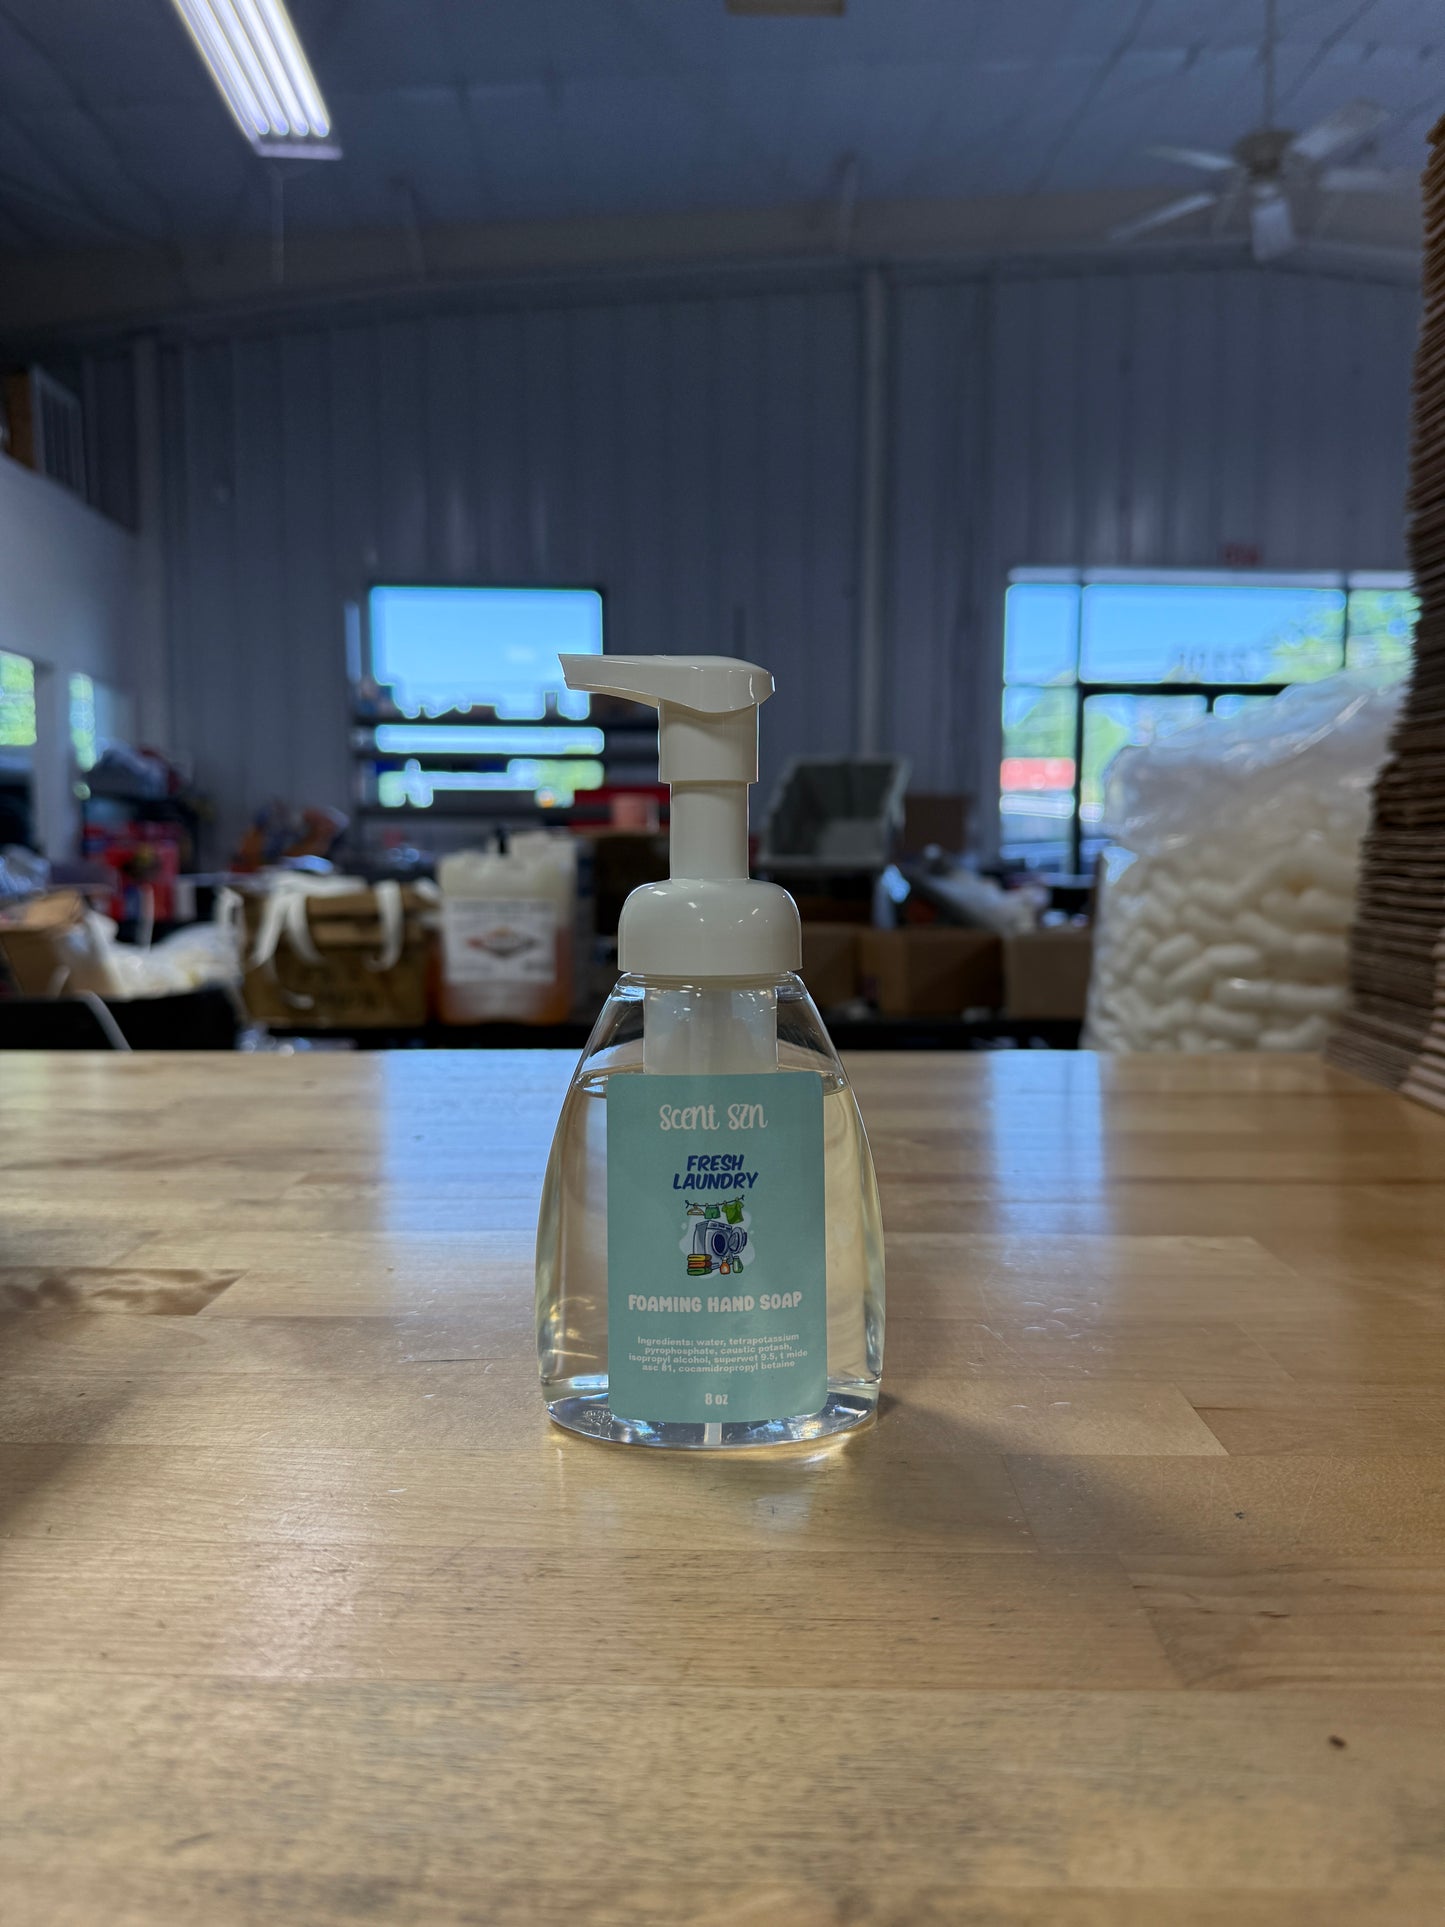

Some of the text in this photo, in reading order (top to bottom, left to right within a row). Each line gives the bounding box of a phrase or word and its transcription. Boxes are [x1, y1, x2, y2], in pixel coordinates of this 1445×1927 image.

[659, 1104, 720, 1131] Scent
[686, 1154, 745, 1172] FRESH
[672, 1171, 759, 1190] LAUNDRY
[628, 1291, 802, 1313] FOAMING HAND SOAP
[637, 1333, 800, 1347] Ingredients: water, tetrapotassium
[628, 1352, 671, 1364] isopropyl
[673, 1355, 712, 1365] alcohol,
[714, 1354, 758, 1364] superwet
[760, 1352, 778, 1361] 9.5,
[786, 1349, 808, 1359] mide
[644, 1343, 793, 1356] pyrophosphate, caustic potash,
[761, 1360, 796, 1370] betaine
[705, 1392, 713, 1406] 8
